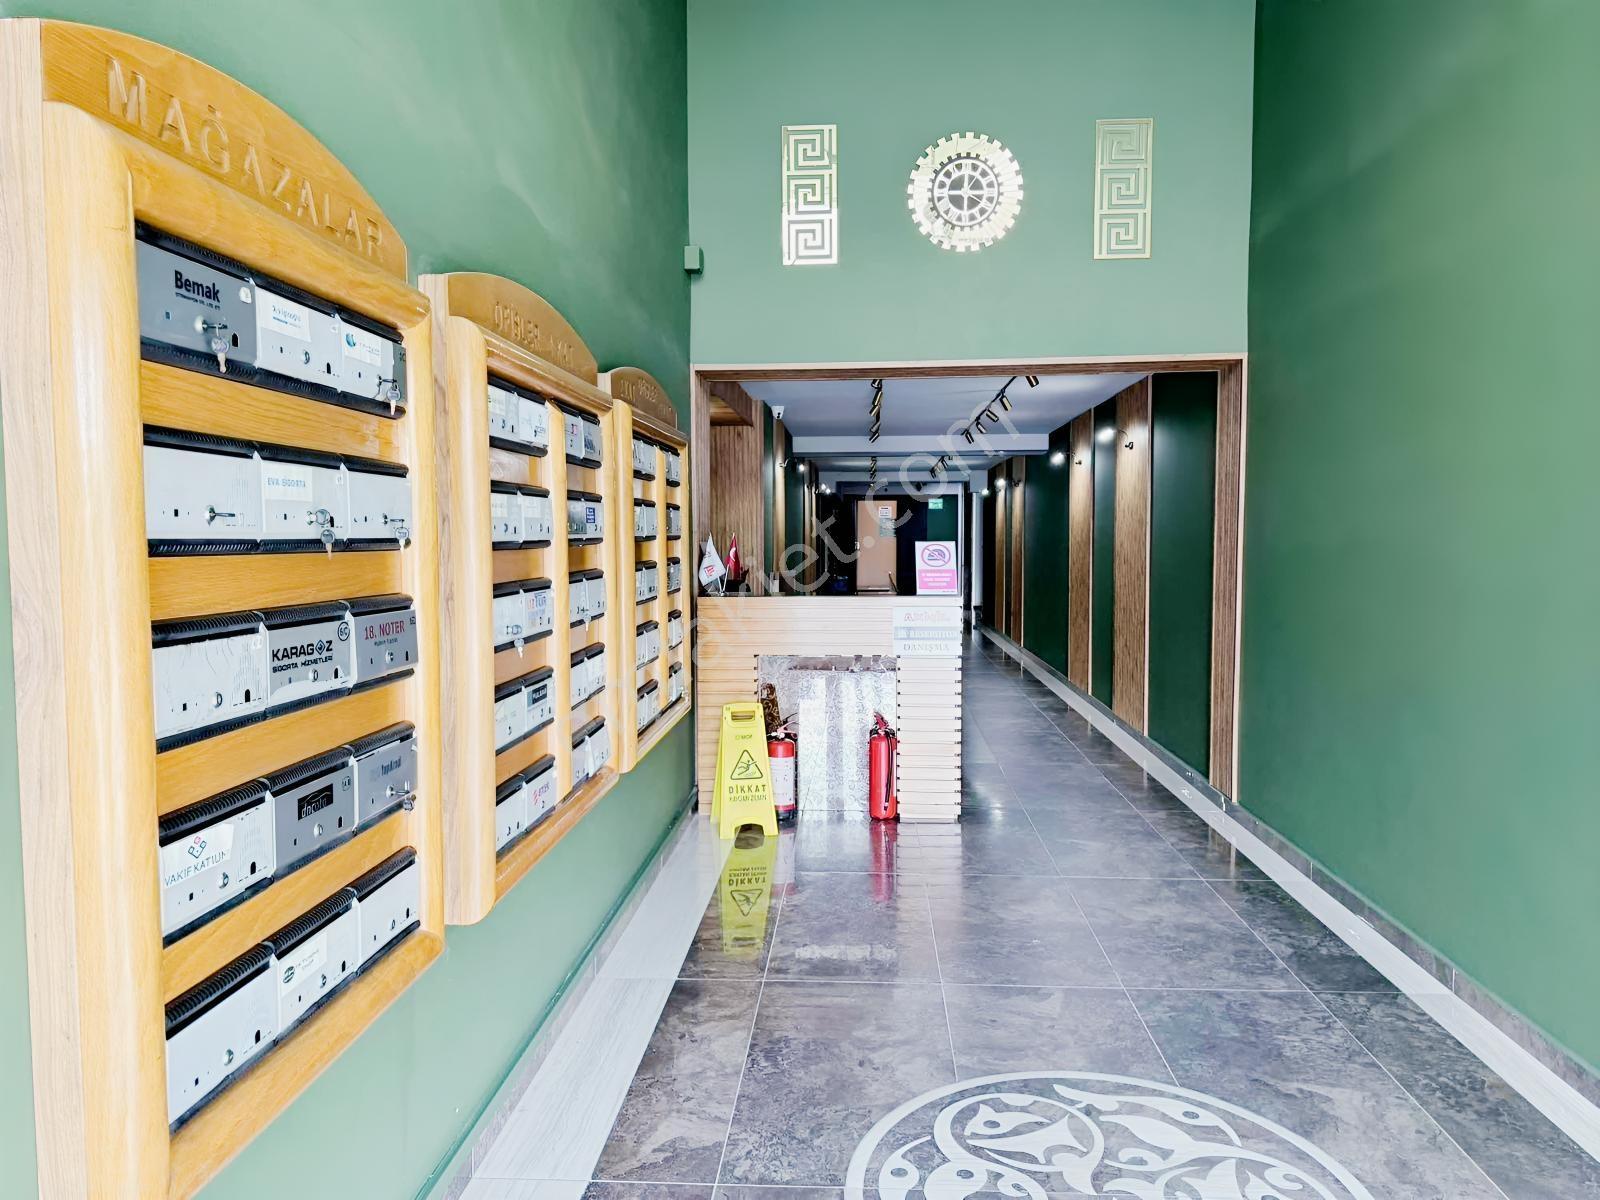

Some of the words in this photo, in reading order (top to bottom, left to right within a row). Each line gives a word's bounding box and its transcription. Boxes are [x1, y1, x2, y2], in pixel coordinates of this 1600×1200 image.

[107, 57, 384, 262] MAĞAZALAR
[174, 269, 220, 303] Bemak
[365, 625, 377, 641] 18.
[379, 620, 405, 636] NOTER
[728, 783, 767, 795] DİKKAT
[164, 866, 192, 887] VAKIF
